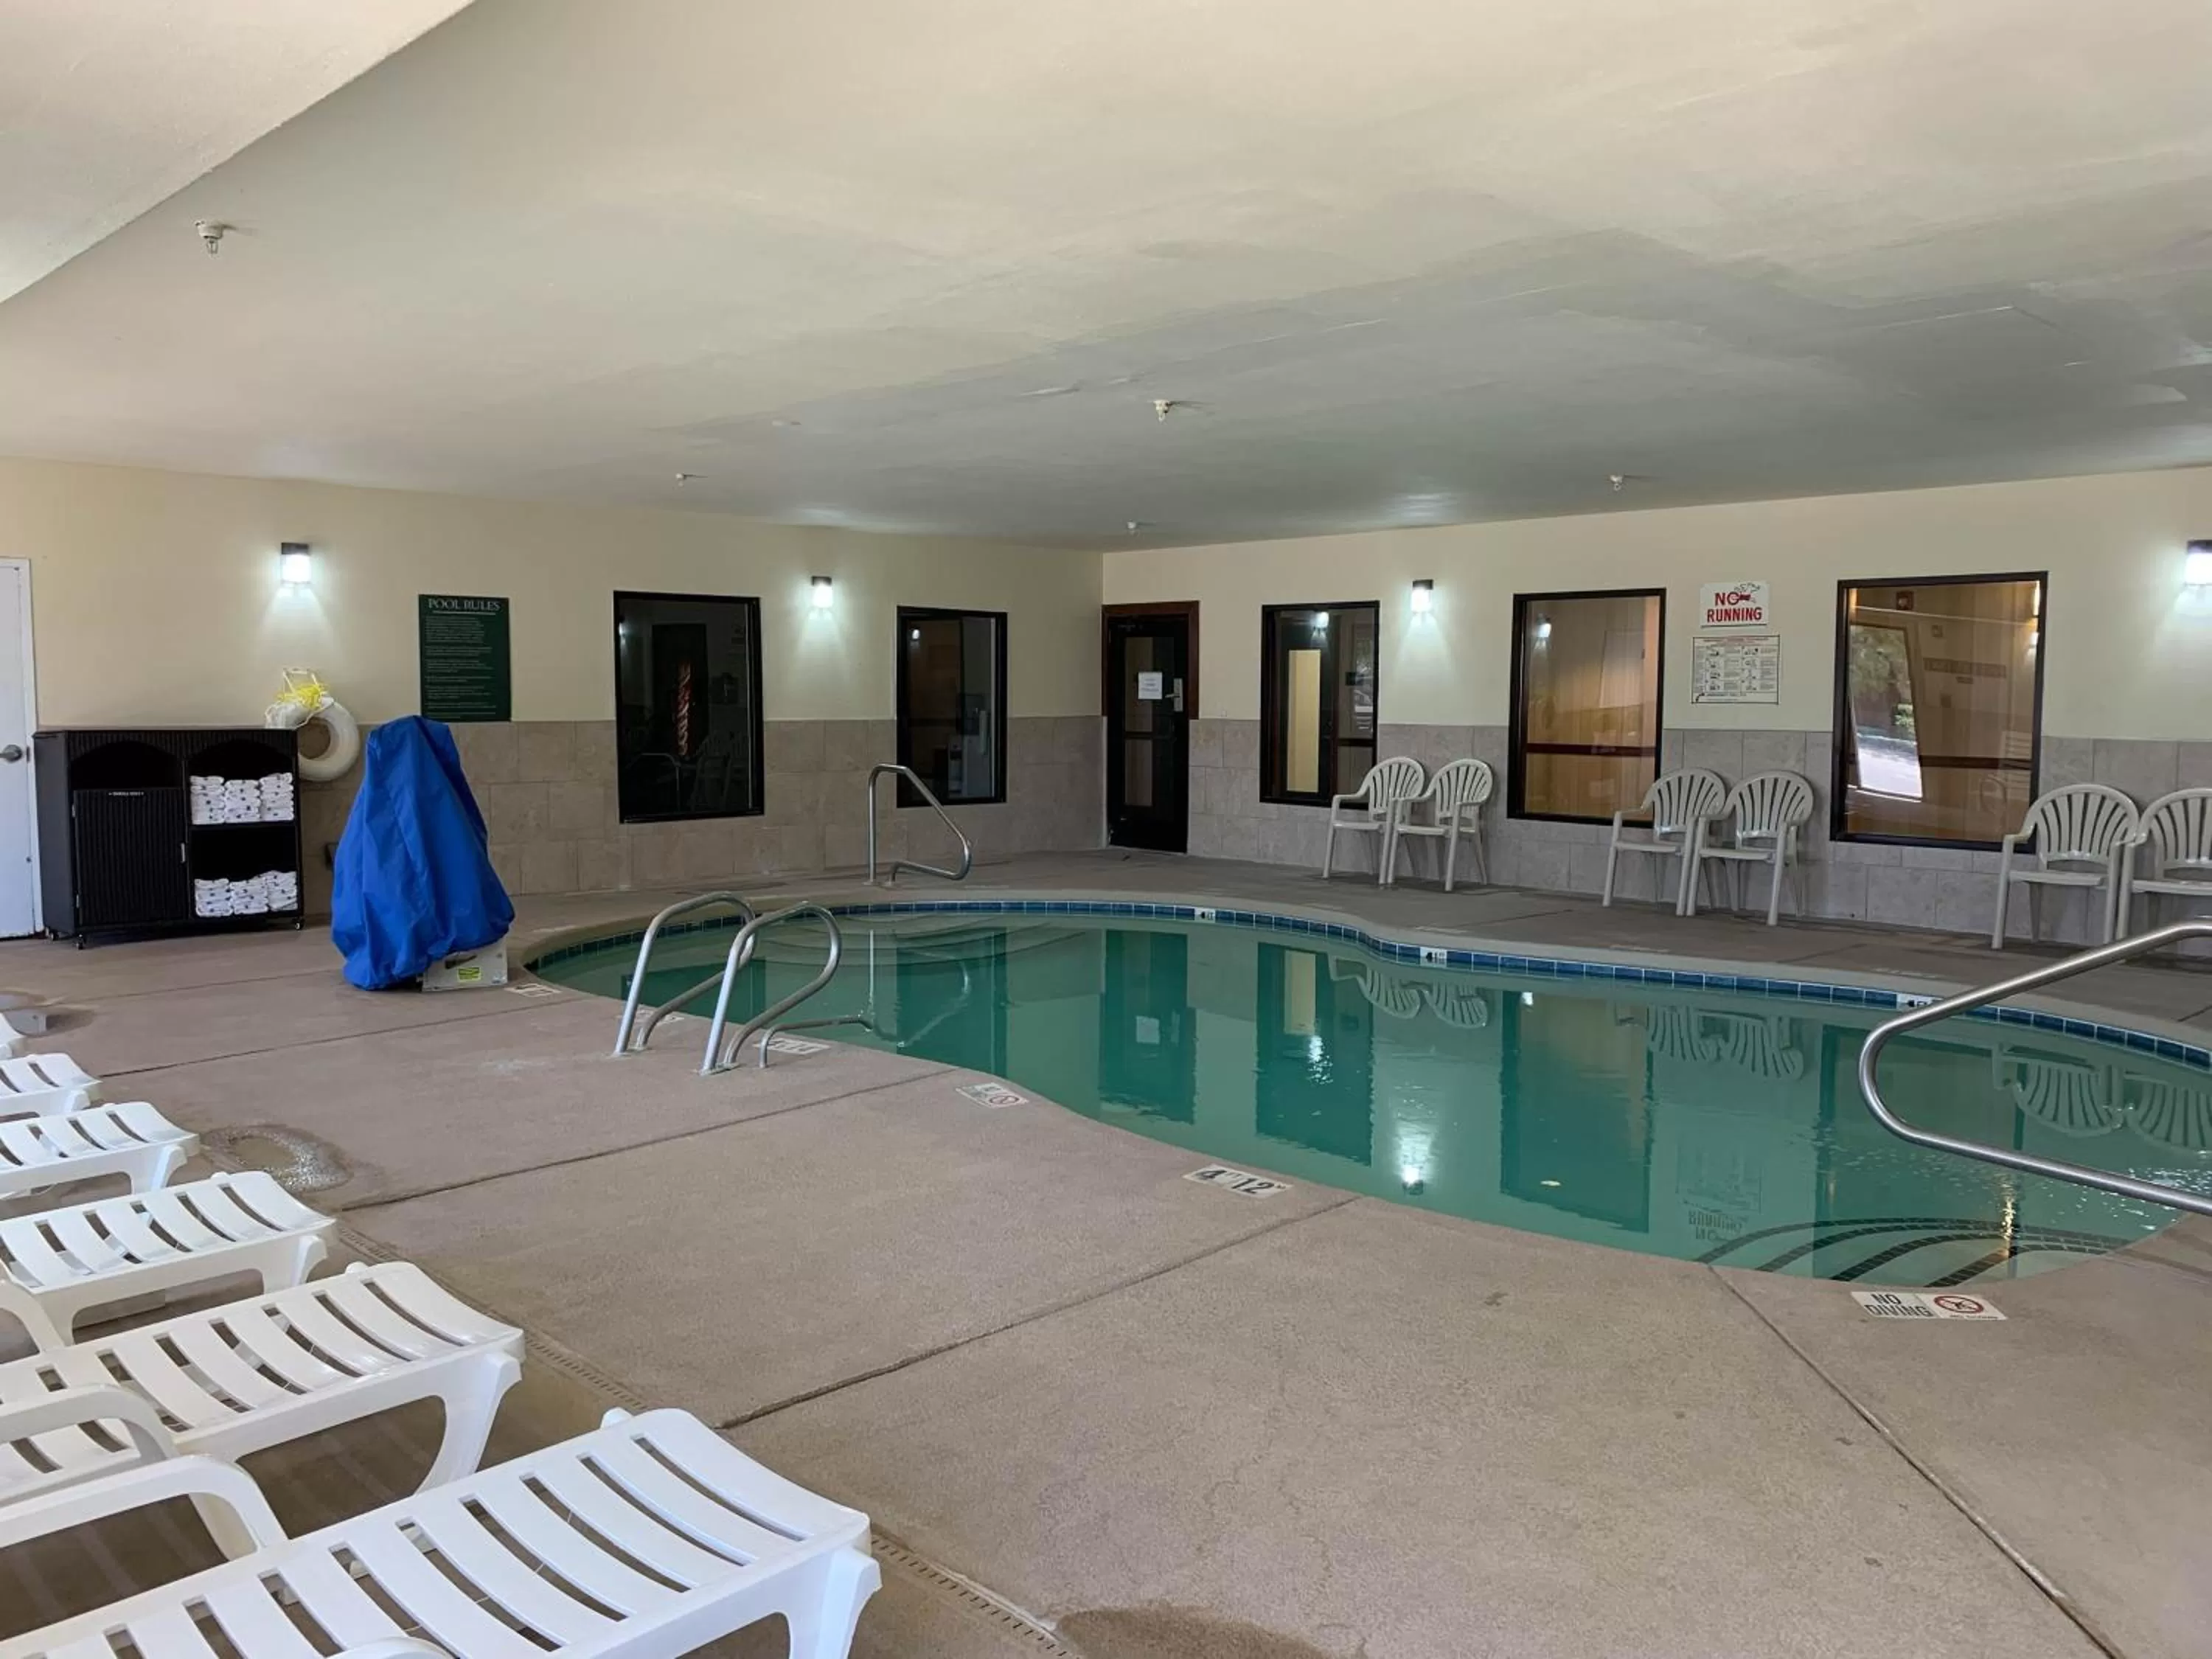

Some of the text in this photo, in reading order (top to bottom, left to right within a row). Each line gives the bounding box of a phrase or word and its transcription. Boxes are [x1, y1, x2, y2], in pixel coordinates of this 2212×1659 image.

[427, 598, 501, 611] POOL RULES
[1714, 591, 1739, 605] NO
[1707, 607, 1762, 622] RUNNING
[1871, 1293, 1902, 1305] NO
[1864, 1304, 1933, 1317] DIVING
